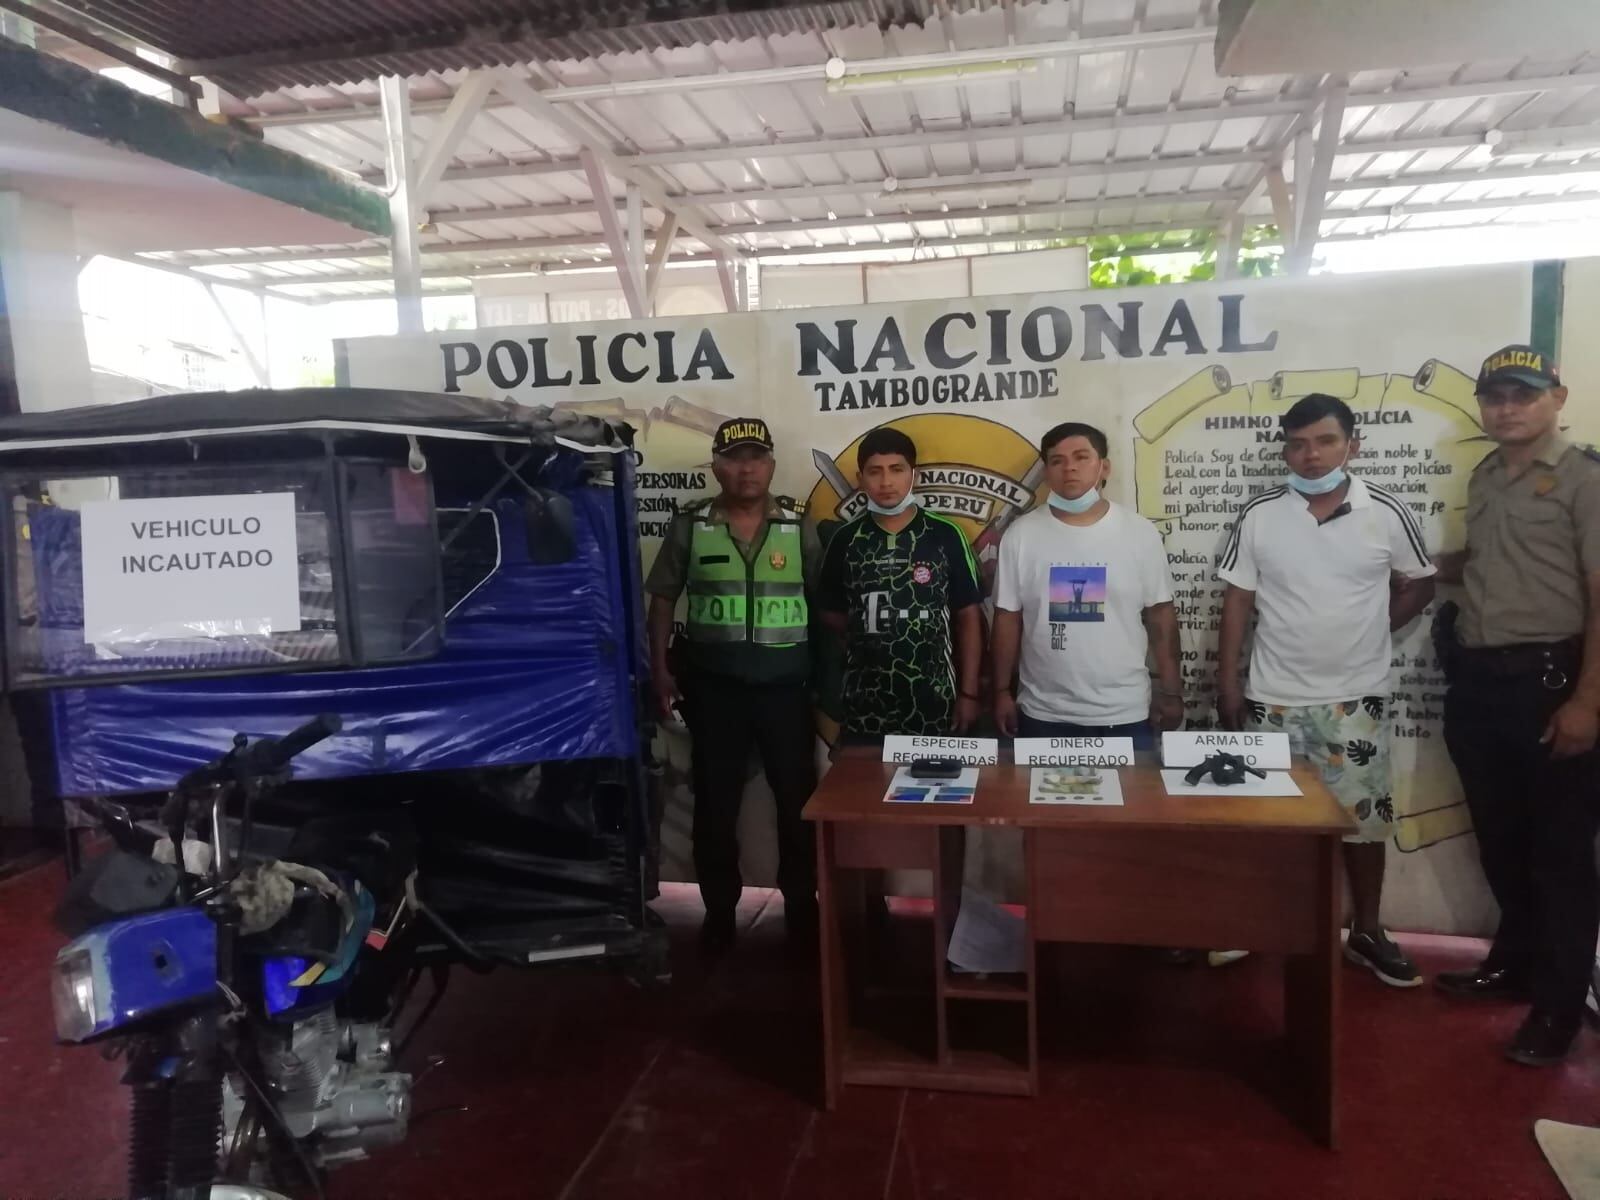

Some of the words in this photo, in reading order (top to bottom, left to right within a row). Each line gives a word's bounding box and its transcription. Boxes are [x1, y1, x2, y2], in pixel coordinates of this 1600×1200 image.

[440, 328, 735, 393] POLICIA
[796, 294, 1279, 377] NACIONAL
[814, 368, 1059, 411] TAMBOGRANDE
[1205, 415, 1273, 430] HIMNO
[1353, 410, 1413, 425] OLICIA
[722, 422, 766, 444] POLICIA
[1210, 448, 1234, 464] Soy
[1240, 448, 1254, 462] de
[1385, 444, 1418, 459] noble
[919, 470, 1022, 504] NACIONAL
[1163, 481, 1183, 496] del
[923, 494, 987, 516] PERU
[131, 516, 261, 540] VEHICULO
[122, 549, 273, 574] INCAUTADO
[692, 596, 805, 625] POLICIA
[912, 737, 979, 750] ESPECIES
[1050, 737, 1104, 749] DINERO
[1195, 735, 1239, 746] ARMA
[1244, 735, 1264, 746] DE
[1029, 754, 1129, 767] RECUPERADO
